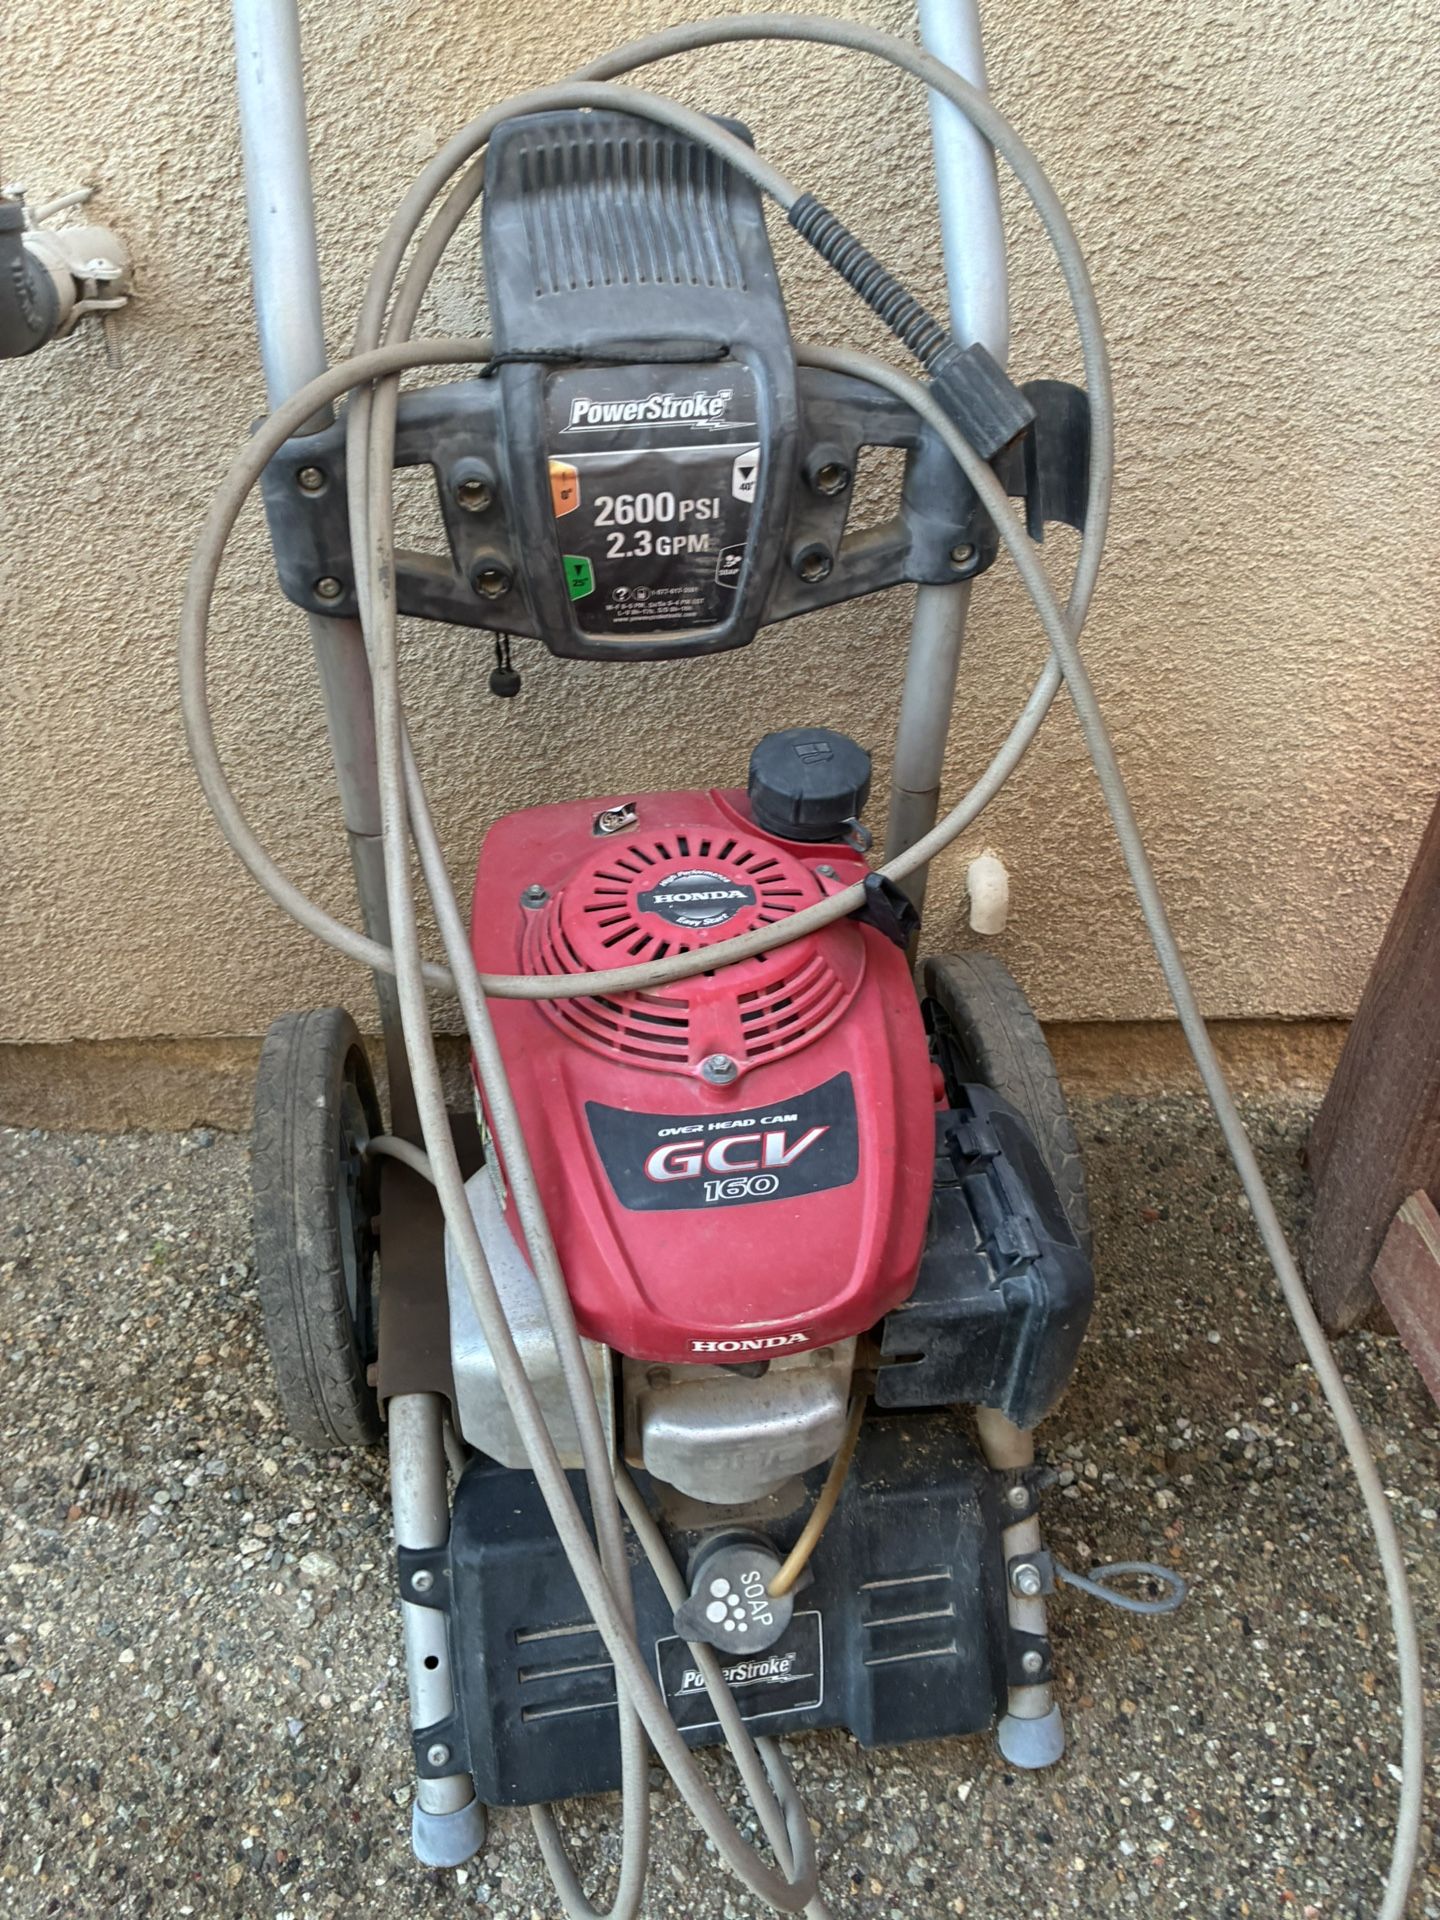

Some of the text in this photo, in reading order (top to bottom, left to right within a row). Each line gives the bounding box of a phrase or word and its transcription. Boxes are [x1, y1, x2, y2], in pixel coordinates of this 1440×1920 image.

[571, 391, 724, 425] PowerStroke
[594, 491, 720, 527] 2600 PSI
[606, 529, 710, 559] 2.3 GPM
[653, 890, 749, 904] HONDA
[702, 913, 730, 926] Start
[657, 1113, 798, 1137] OVER HEAD CAM
[644, 1125, 830, 1183] GCV
[704, 1174, 780, 1202] 160
[691, 1332, 810, 1352] HONDA
[740, 1570, 774, 1626] SOAP
[683, 1657, 790, 1689] PoerStroke
